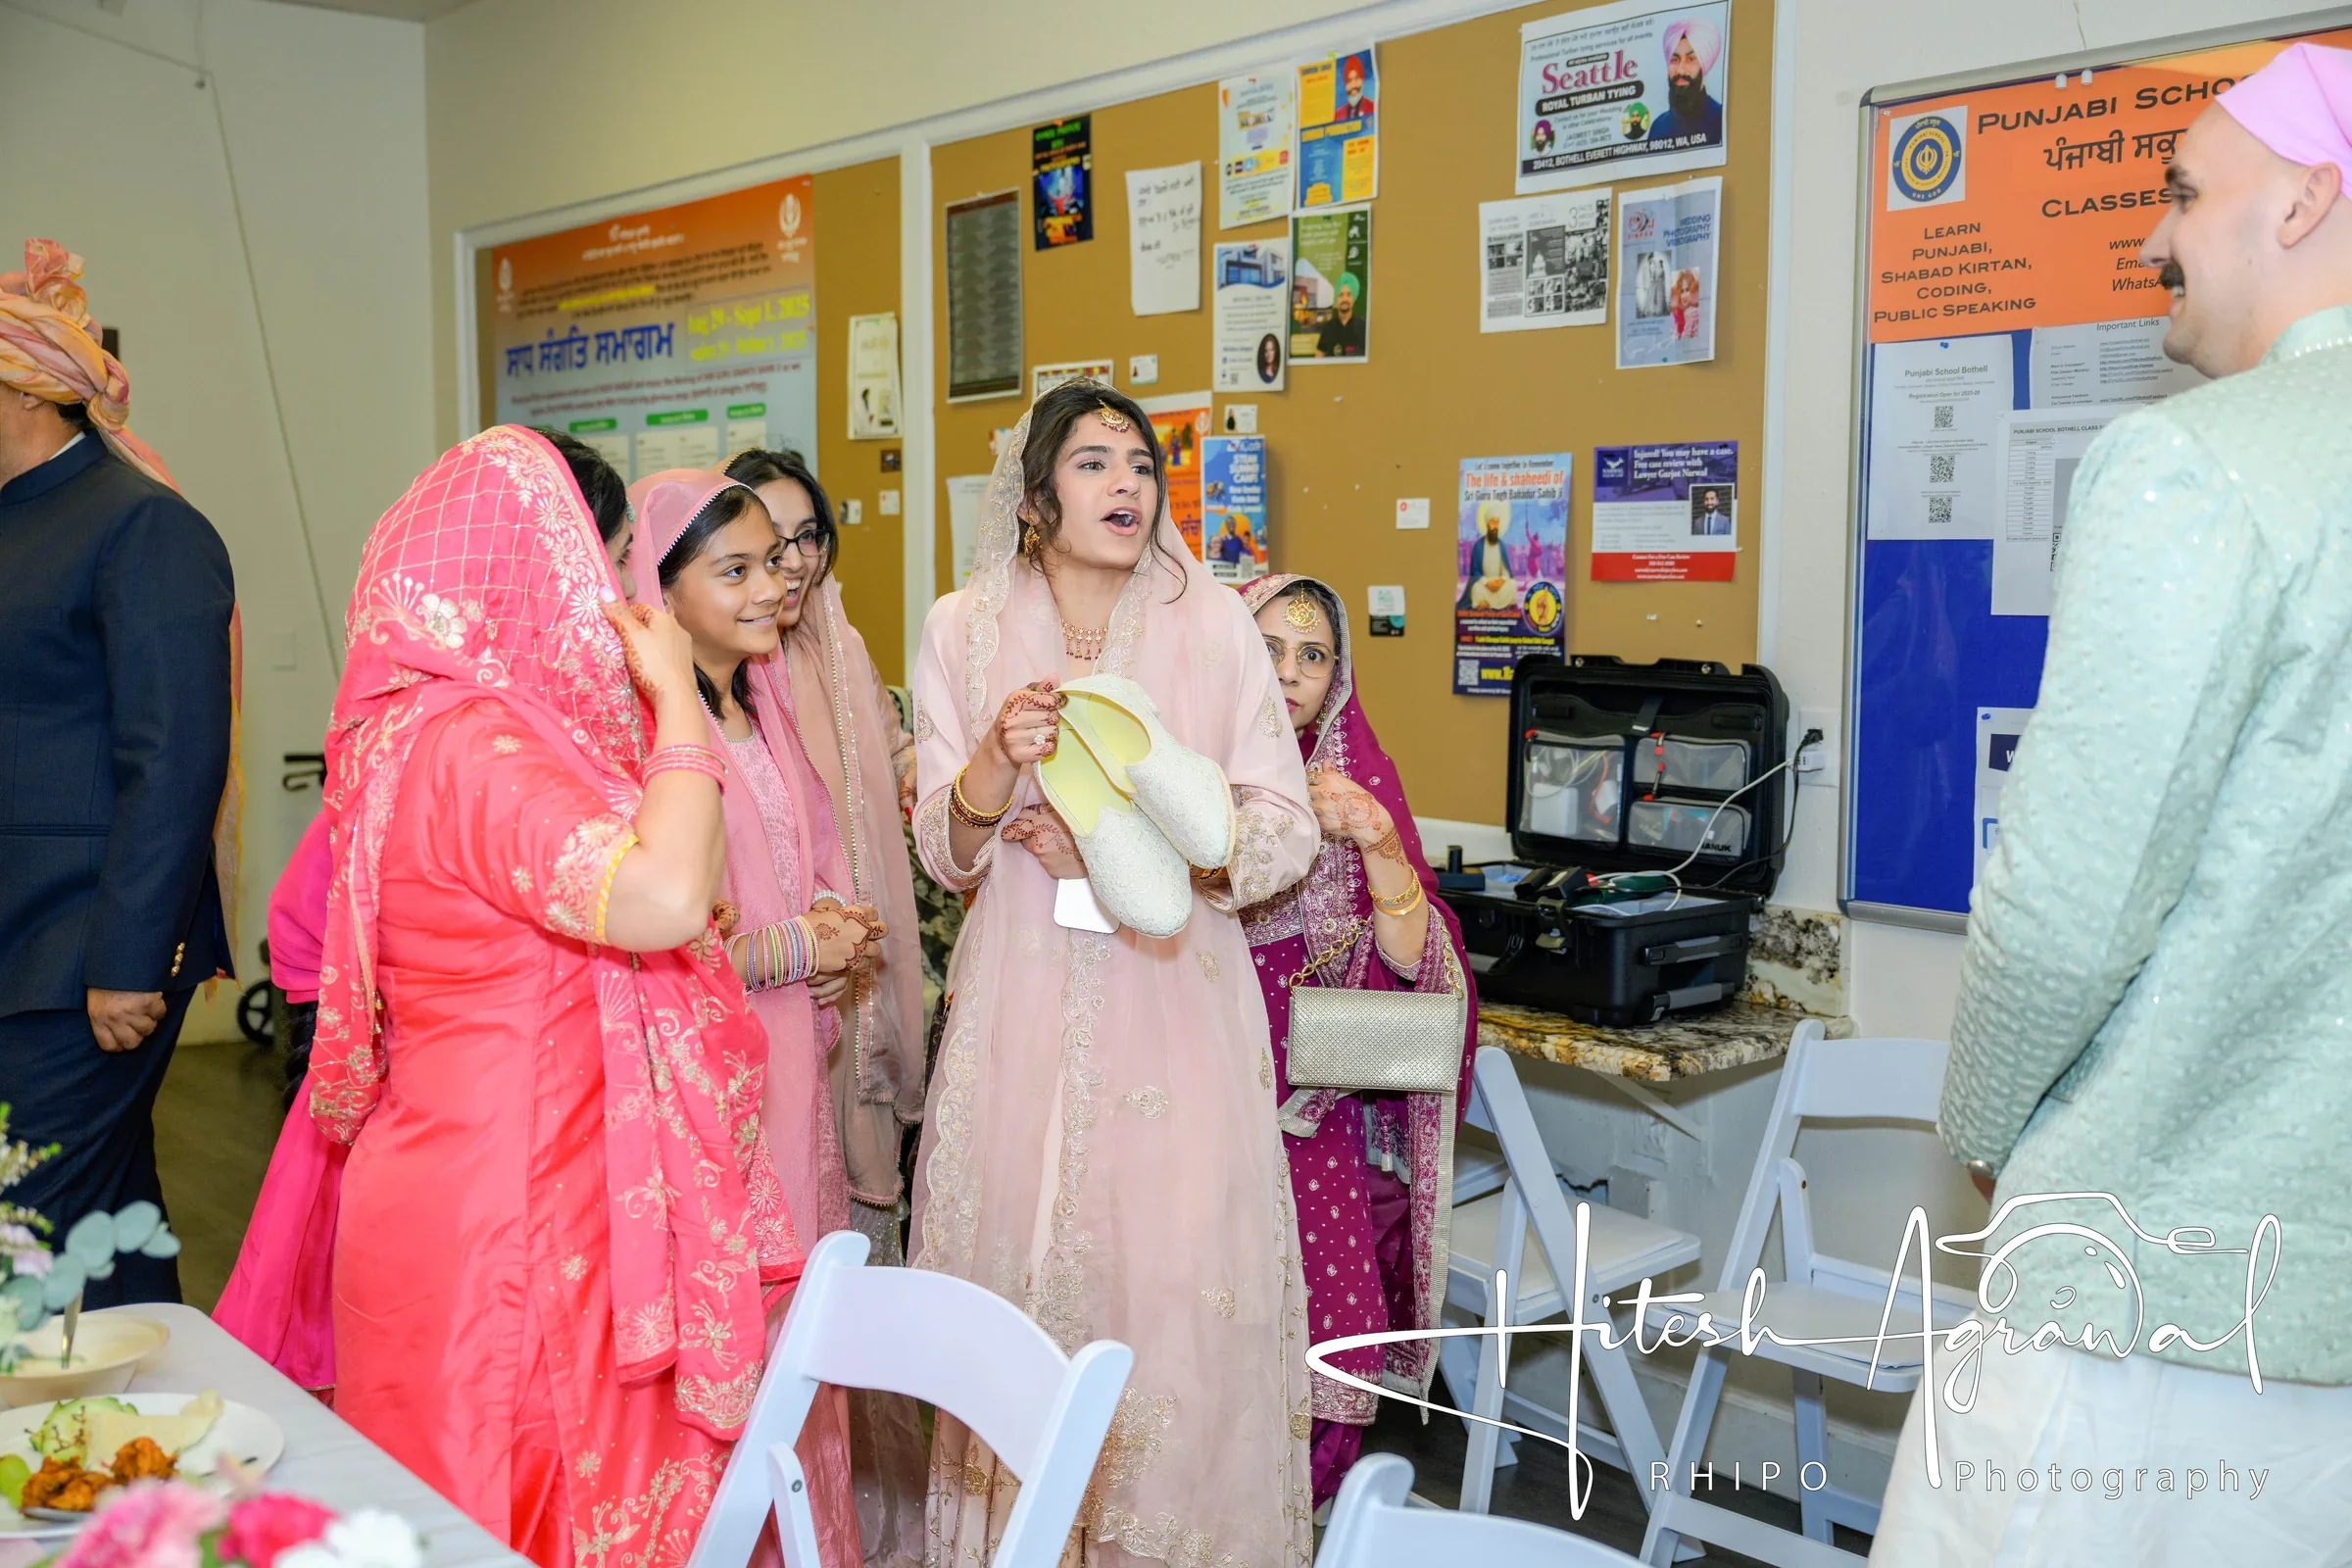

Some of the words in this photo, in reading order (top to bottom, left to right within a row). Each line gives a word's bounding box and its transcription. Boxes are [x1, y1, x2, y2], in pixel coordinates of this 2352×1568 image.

[1542, 49, 1638, 95] Seattle
[1542, 96, 1569, 113] ROYAL
[1570, 90, 1607, 108] TURBAN
[1607, 85, 1637, 101] TYING
[1978, 96, 2117, 134] PUNJABI
[2134, 74, 2255, 109] SCHO
[1555, 153, 1586, 167] BOTHELL
[1690, 132, 1707, 145] USA
[2043, 128, 2126, 172] ਪੰਜਾਬੀ
[2132, 127, 2189, 165] ਸਕੂ
[1680, 214, 1711, 226] WEDDING
[1663, 222, 1711, 239] PHOTOGRAPHY
[1924, 222, 1981, 240] LEARN
[1912, 242, 1992, 261] PUNJABI,
[1881, 266, 1953, 284] SHABAD
[1958, 258, 2033, 275] KIRTAN,
[1917, 282, 1992, 300] CODING,
[1874, 307, 1937, 323] PUBLIC
[1942, 297, 2036, 317] SPEAKING
[2097, 319, 2136, 332] Important
[2138, 318, 2160, 327] Links
[1904, 369, 1933, 378] Punjabi
[1961, 365, 1988, 373] Bothell
[1661, 449, 1675, 459] You
[1675, 450, 1690, 460] may
[1691, 447, 1709, 457] have
[1634, 460, 1648, 469] Free
[1662, 459, 1685, 468] review
[1686, 458, 1702, 466] with
[1465, 472, 1482, 489] The
[1483, 471, 1498, 487] life
[1500, 471, 1507, 486] &
[1510, 469, 1551, 486] shaheedi
[1553, 469, 1564, 485] of
[1634, 470, 1657, 481] Lawyer
[1682, 467, 1708, 477] Narwal
[1464, 490, 1474, 502] Sri
[1475, 490, 1491, 502] Guru
[1493, 489, 1508, 502] Tegh
[1537, 488, 1556, 499] Sahib
[1697, 841, 1732, 852] ANUK
